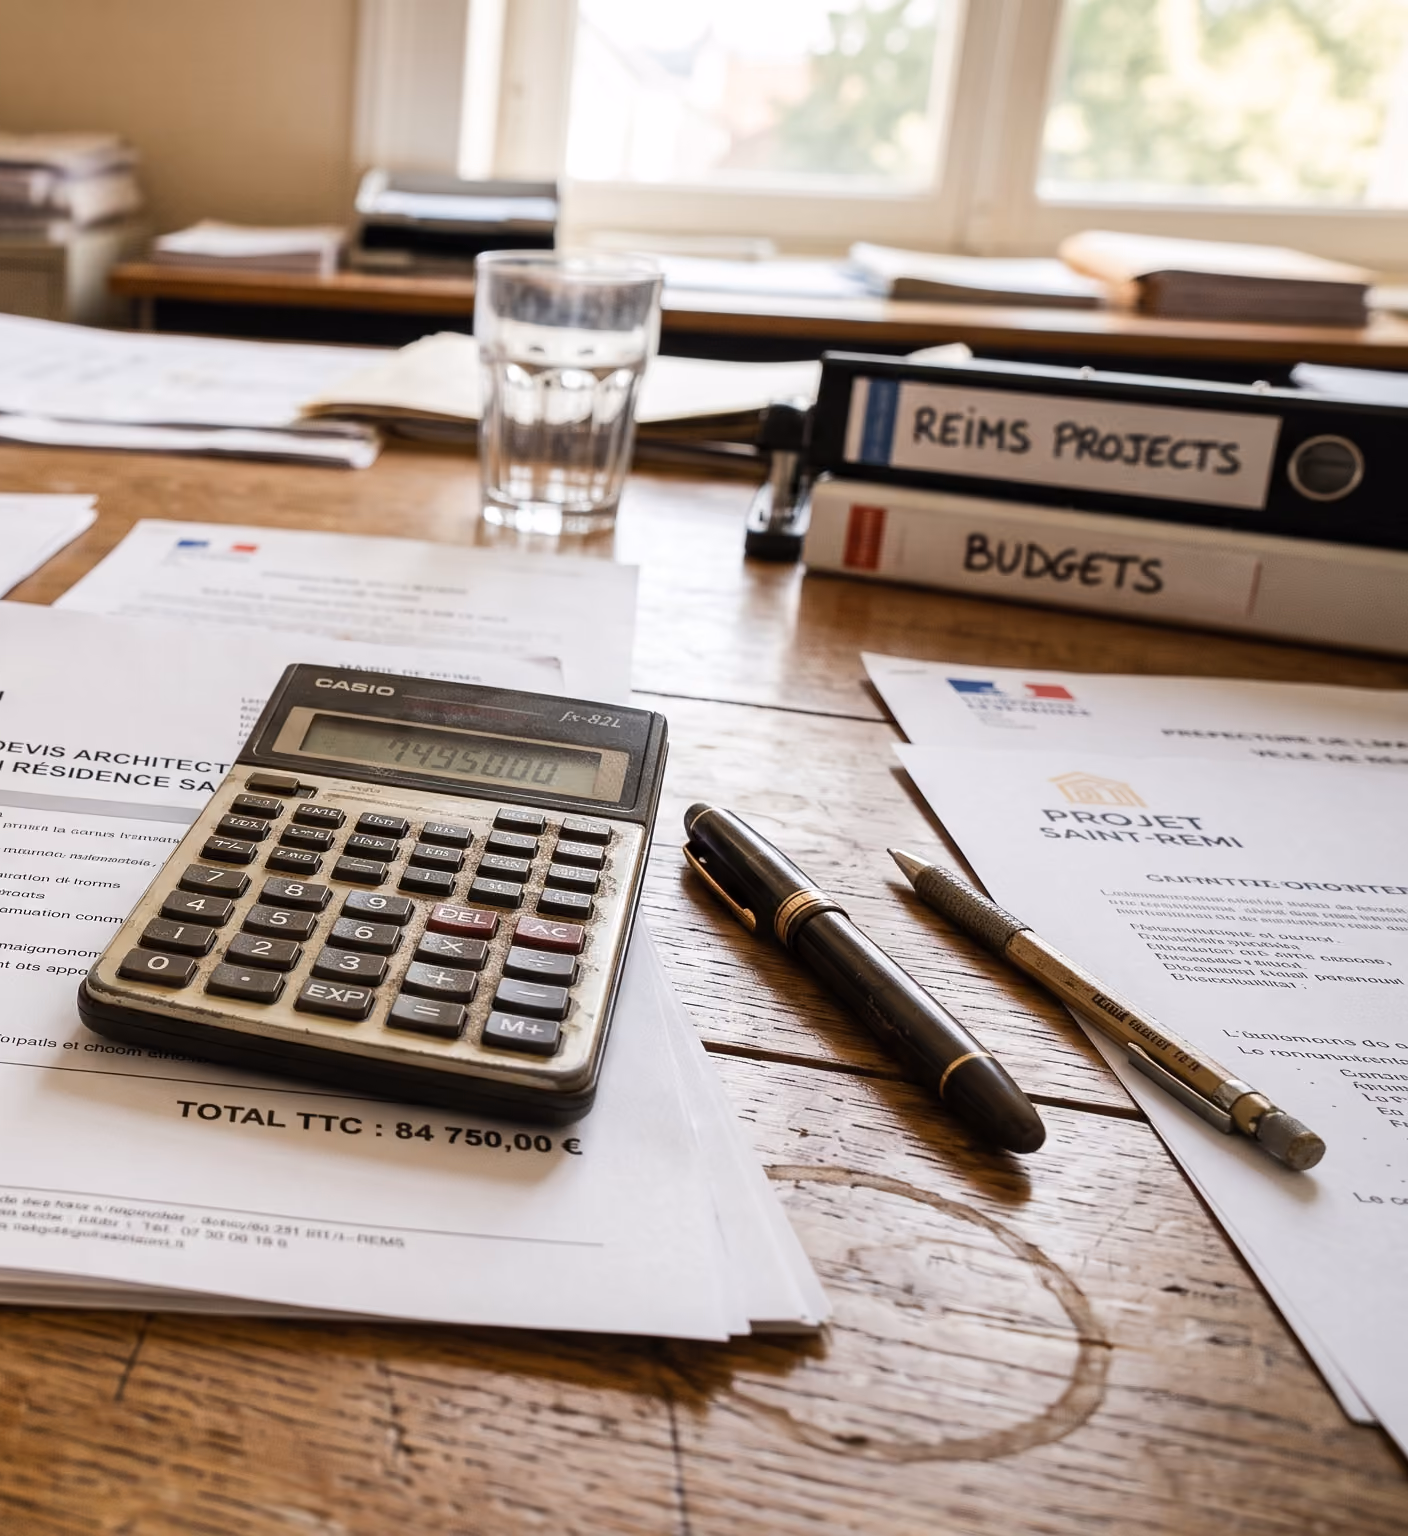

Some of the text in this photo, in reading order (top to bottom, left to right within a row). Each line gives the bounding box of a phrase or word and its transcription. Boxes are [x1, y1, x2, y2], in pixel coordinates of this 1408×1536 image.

[1052, 420, 1243, 476] PROJECTS
[962, 532, 1165, 595] BUDGETS
[314, 677, 395, 697] CASIO
[12, 759, 171, 791] RÉSIDENCE
[179, 775, 216, 793] SA
[1039, 827, 1245, 849] SAINT-REMI
[1041, 808, 1204, 831] PROJET
[185, 898, 206, 912] 4
[268, 911, 291, 926] 5
[353, 925, 375, 940] 6
[206, 869, 488, 926] 7 8 9 DEL
[173, 926, 185, 939] 1
[250, 940, 273, 956] 2
[338, 955, 362, 971] 3
[146, 955, 170, 970] 0
[304, 983, 366, 1004] EXP
[499, 1017, 545, 1036] M+
[176, 1100, 286, 1128] TOTAL
[296, 1112, 363, 1136] TTC
[394, 1121, 435, 1143] 84
[444, 1126, 553, 1154] 750,00
[561, 1137, 585, 1156] €
